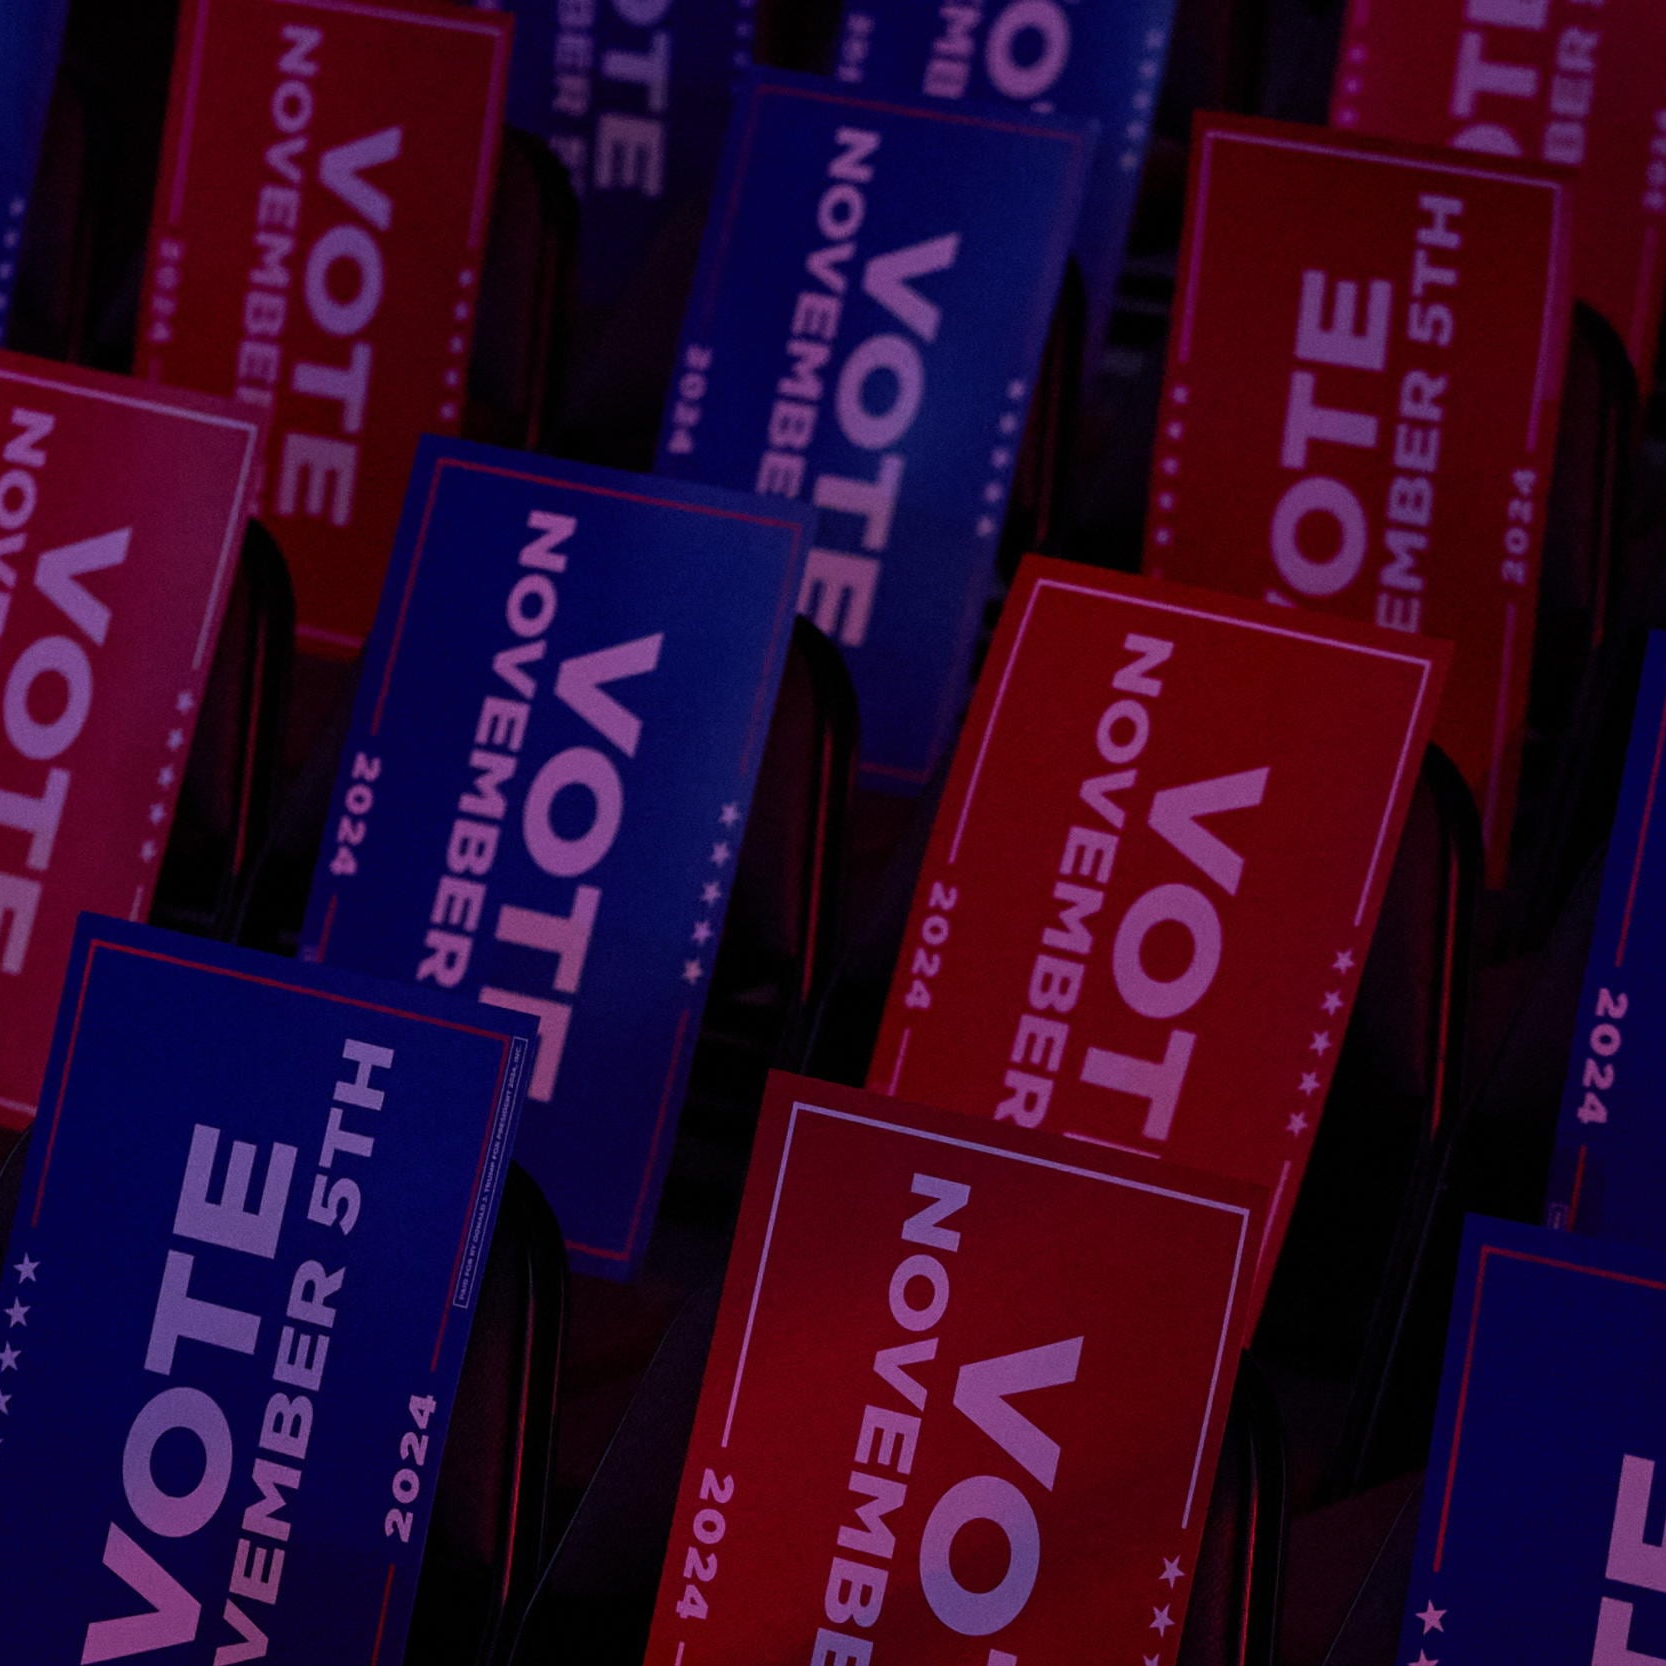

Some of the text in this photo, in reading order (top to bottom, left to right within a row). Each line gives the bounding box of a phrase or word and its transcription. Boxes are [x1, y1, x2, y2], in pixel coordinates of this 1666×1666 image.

[238, 26, 321, 406] NOVEMBE
[595, 0, 670, 196] TE
[279, 127, 401, 525] VOTE
[756, 128, 880, 499] NOVEMBE
[793, 233, 960, 647] VOTE
[1267, 270, 1391, 606] OTE
[1377, 195, 1463, 633] EMBER 5TH
[1502, 470, 1536, 582] 2024
[330, 752, 381, 875] 2024
[416, 510, 577, 987] NOVEMBER
[994, 633, 1174, 1129] NOVEMBER
[905, 882, 957, 1008] 2024
[1064, 767, 1270, 1159] VOT
[1577, 987, 1629, 1124] 2024
[307, 1038, 395, 1235] 5TH
[80, 1123, 298, 1666] VOTE
[384, 1394, 437, 1543] 2024
[675, 1468, 735, 1620] 2024
